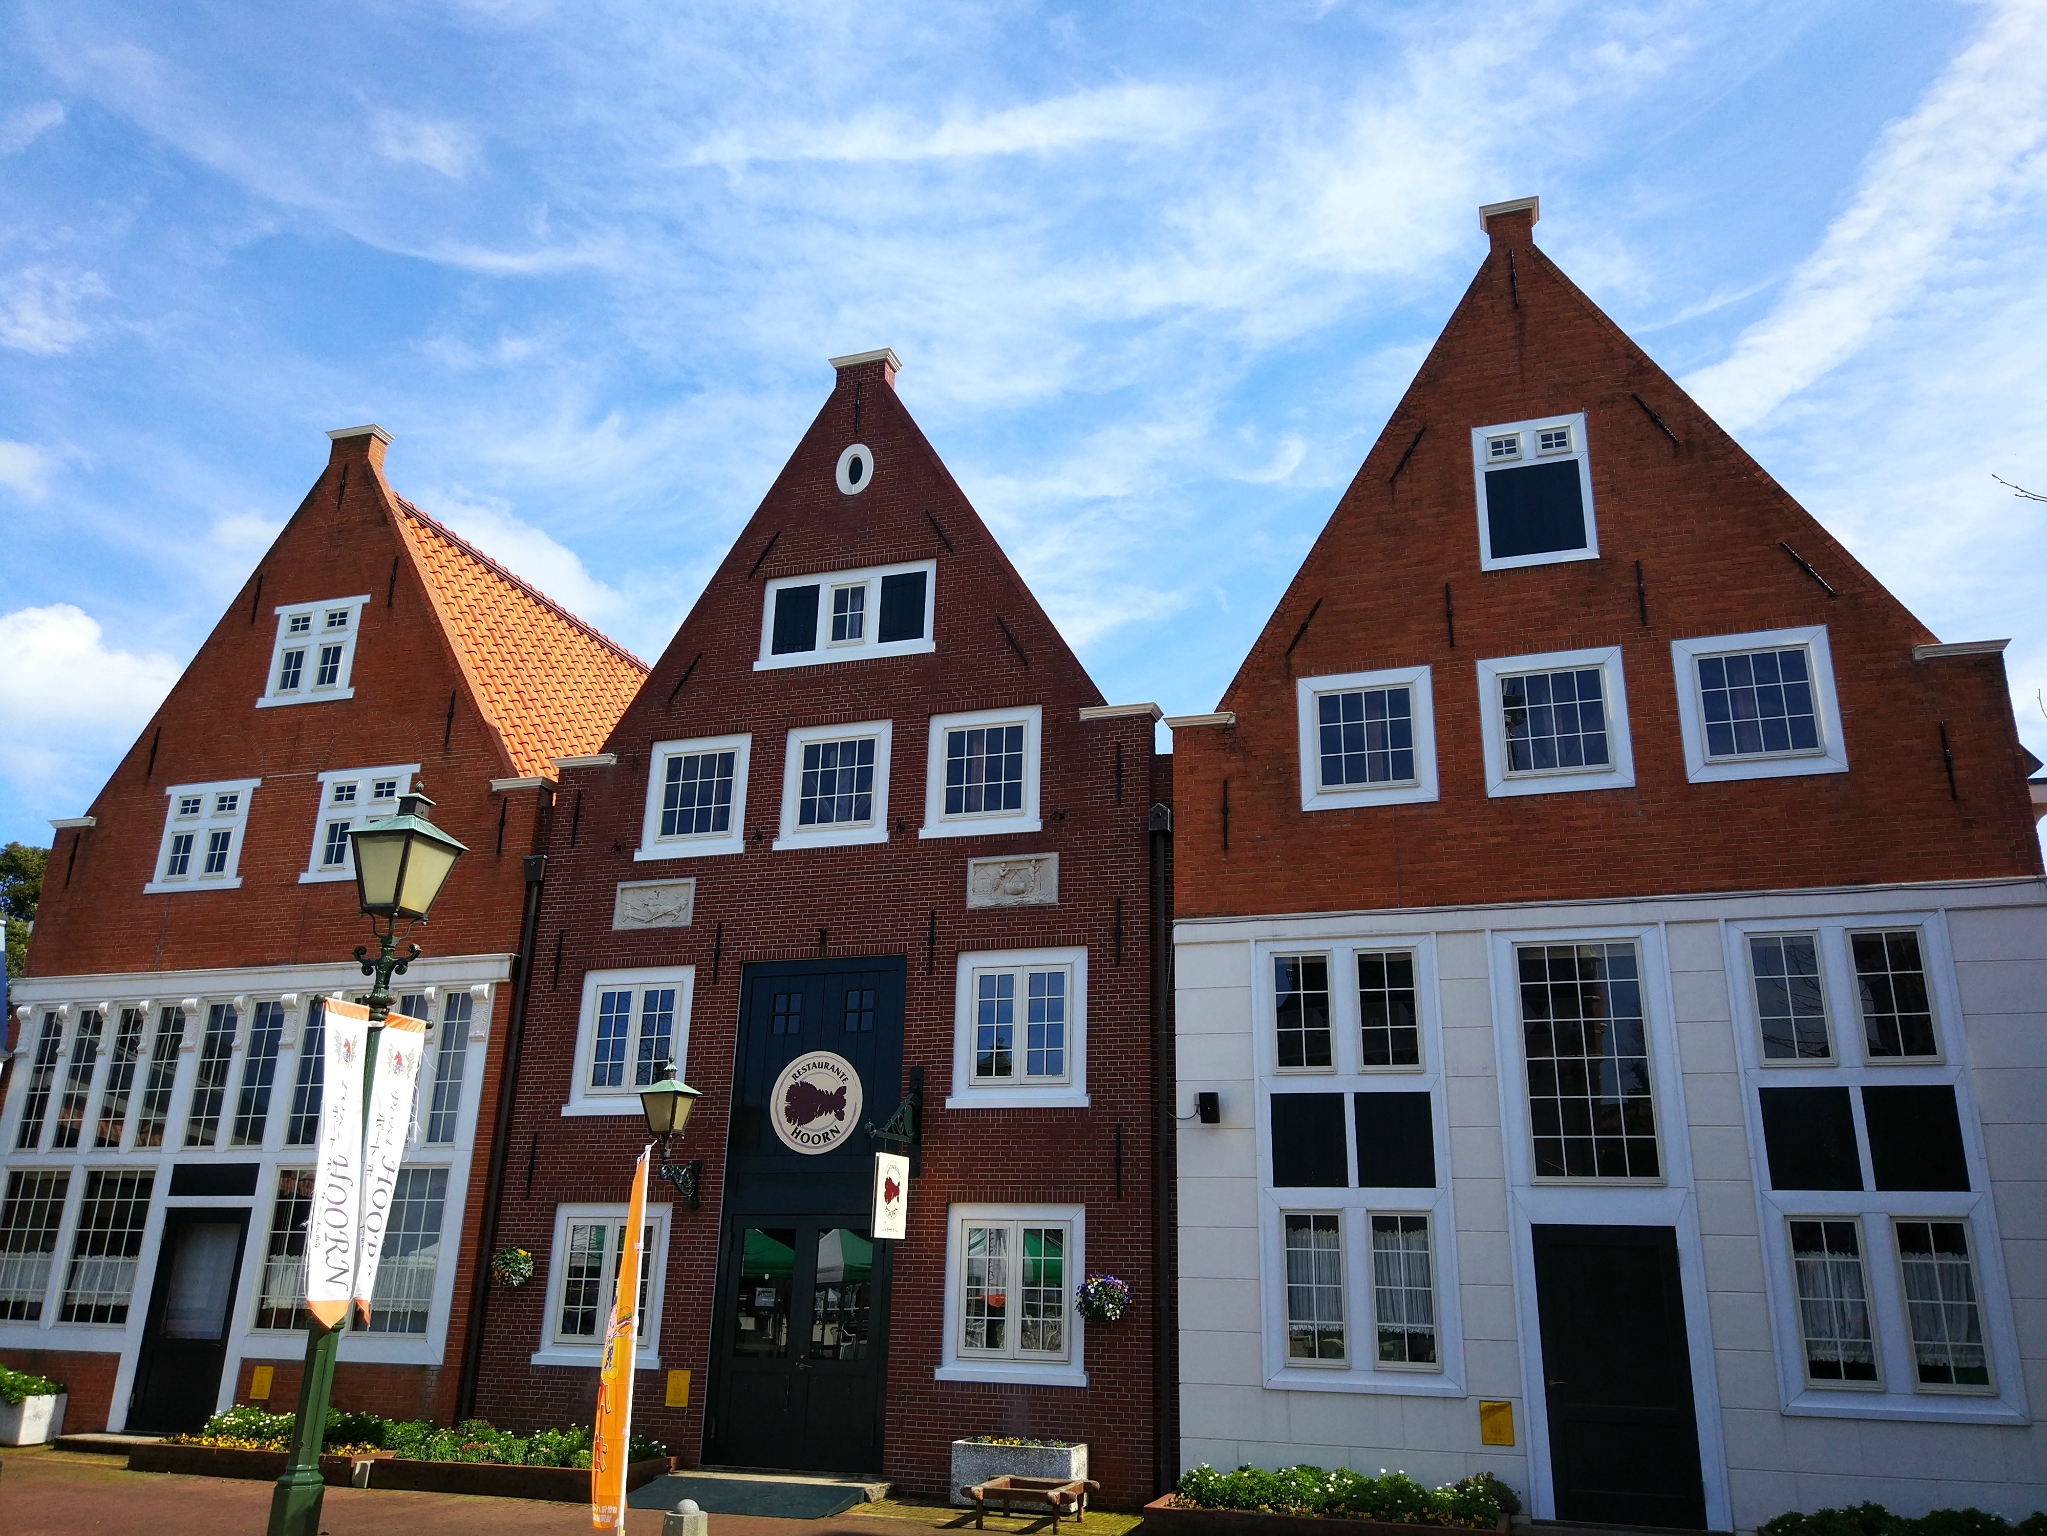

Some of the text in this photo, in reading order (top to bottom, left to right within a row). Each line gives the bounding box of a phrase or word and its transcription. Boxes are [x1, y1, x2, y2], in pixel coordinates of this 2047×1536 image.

[791, 1061, 849, 1084] RESTAURANTE
[790, 1125, 841, 1145] HOORN
[323, 1154, 354, 1292] HOORN
